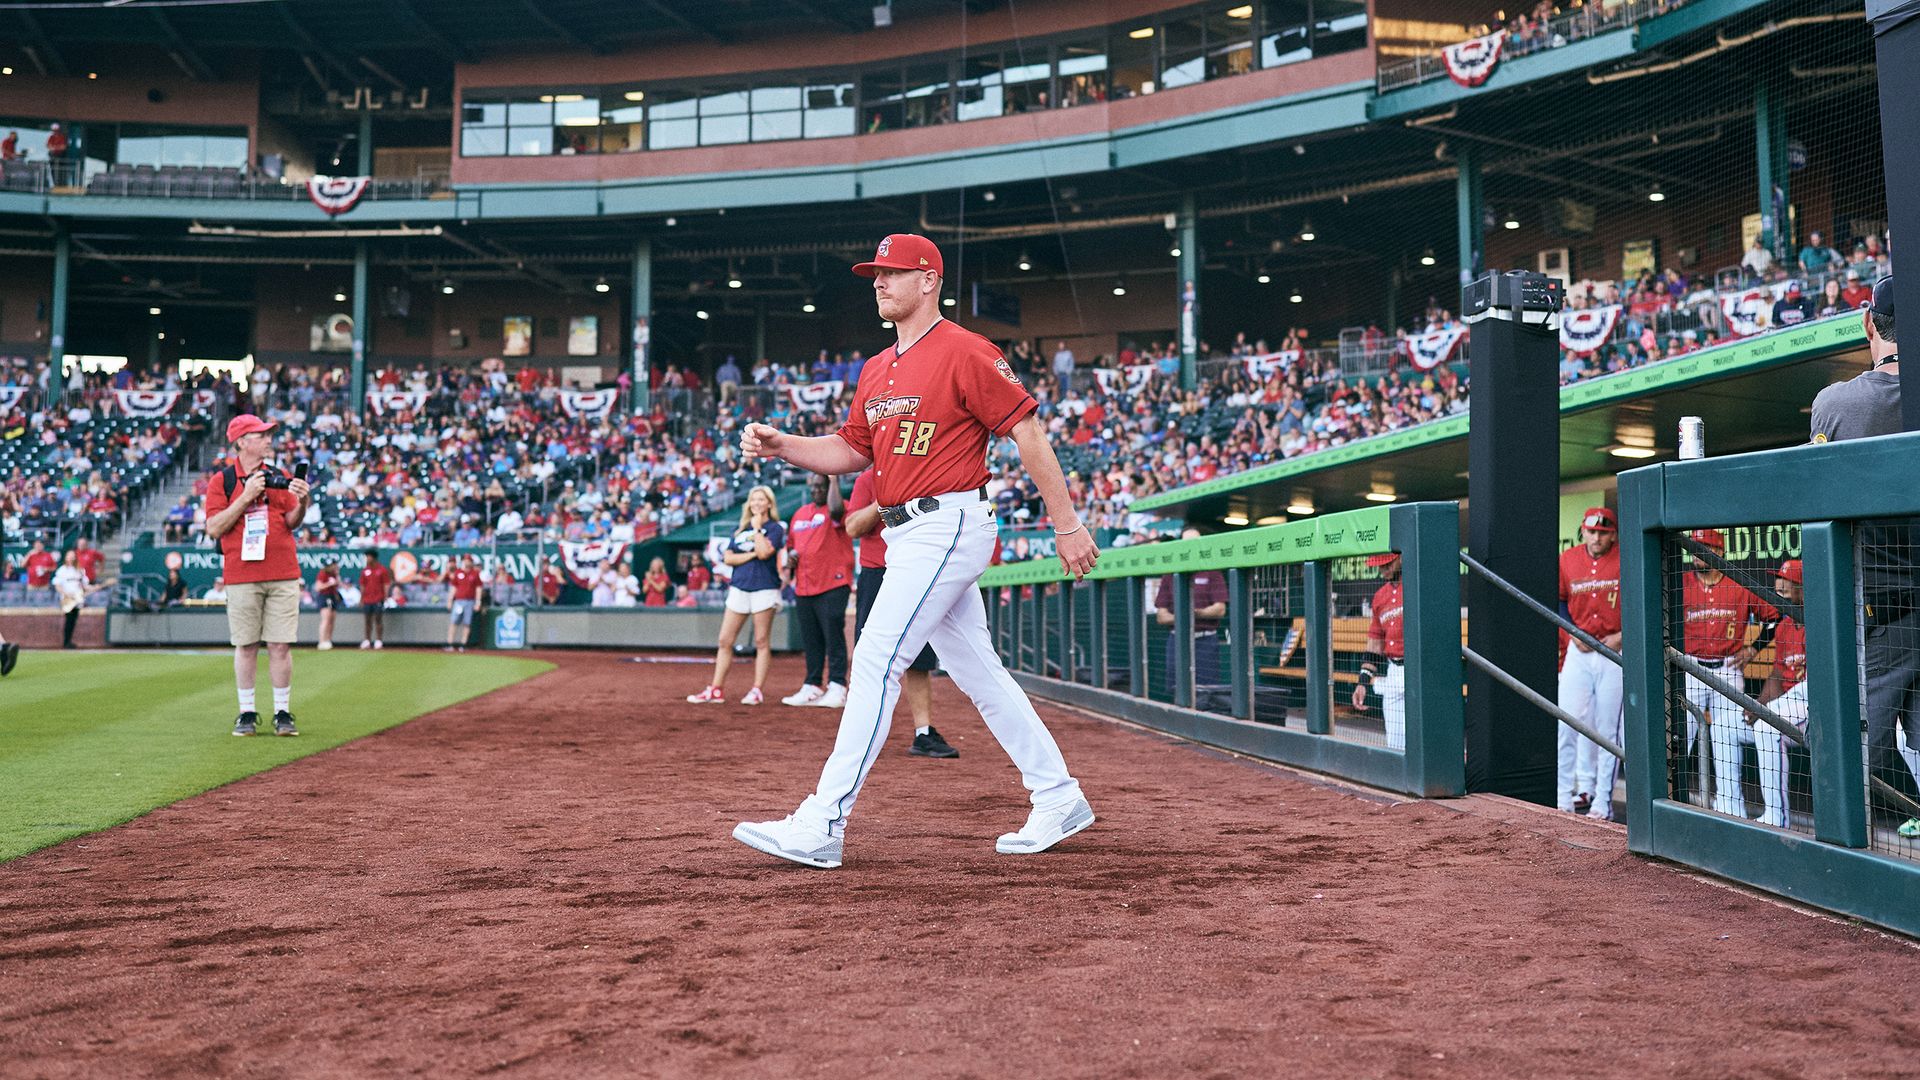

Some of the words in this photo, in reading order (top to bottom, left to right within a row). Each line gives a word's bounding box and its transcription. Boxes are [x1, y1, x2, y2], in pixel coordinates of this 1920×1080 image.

[1751, 344, 1775, 357] TRUGREEN
[1790, 334, 1816, 347] TRUGREEN
[1835, 324, 1863, 338] TRUGREEN
[893, 420, 937, 457] 38
[184, 553, 224, 569] PNC
[1607, 592, 1618, 609] 4
[1727, 622, 1735, 640] 6
